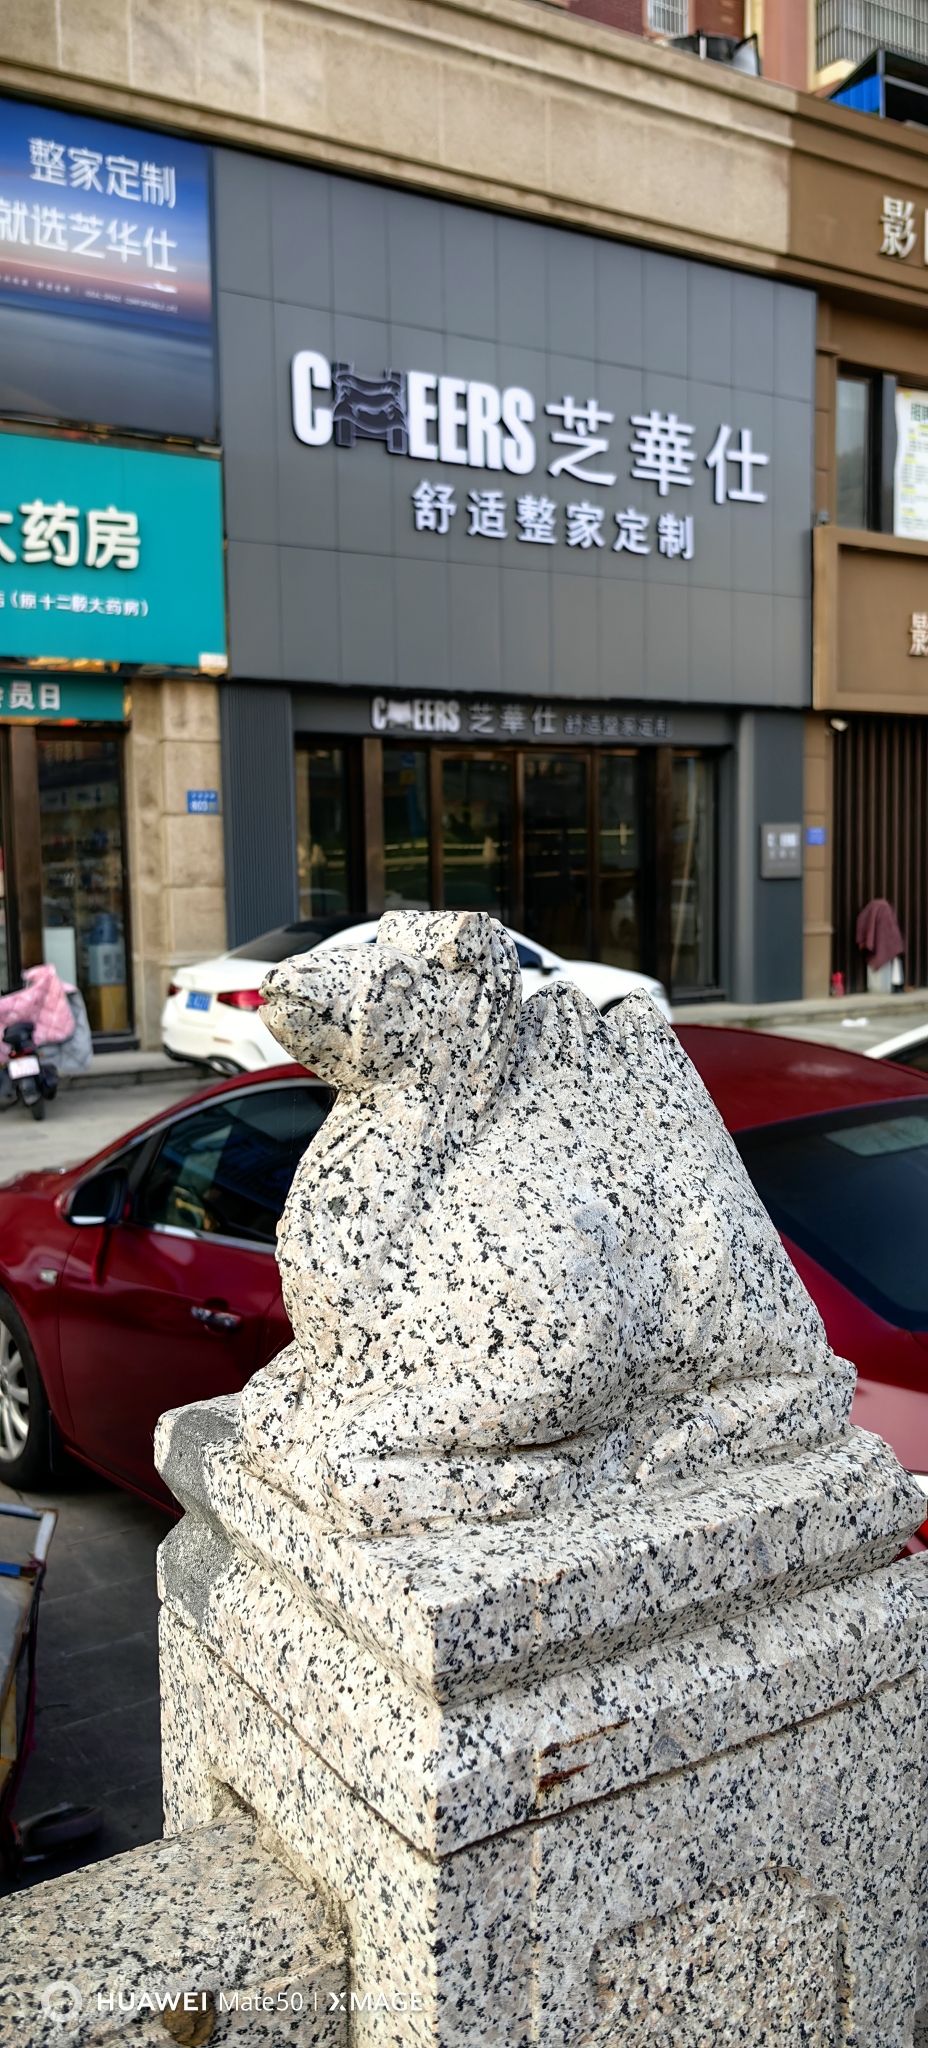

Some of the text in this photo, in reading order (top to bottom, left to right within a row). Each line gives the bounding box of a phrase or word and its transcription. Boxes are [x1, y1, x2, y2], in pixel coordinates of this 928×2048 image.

[29, 137, 176, 208] 整家定制
[0, 197, 178, 272] 就选芝华仕
[880, 195, 928, 265] 影
[546, 395, 770, 505] 芝華仕
[412, 480, 695, 560] 舒适整家定制
[0, 680, 60, 710] 员日
[469, 702, 557, 736] 芝華仕
